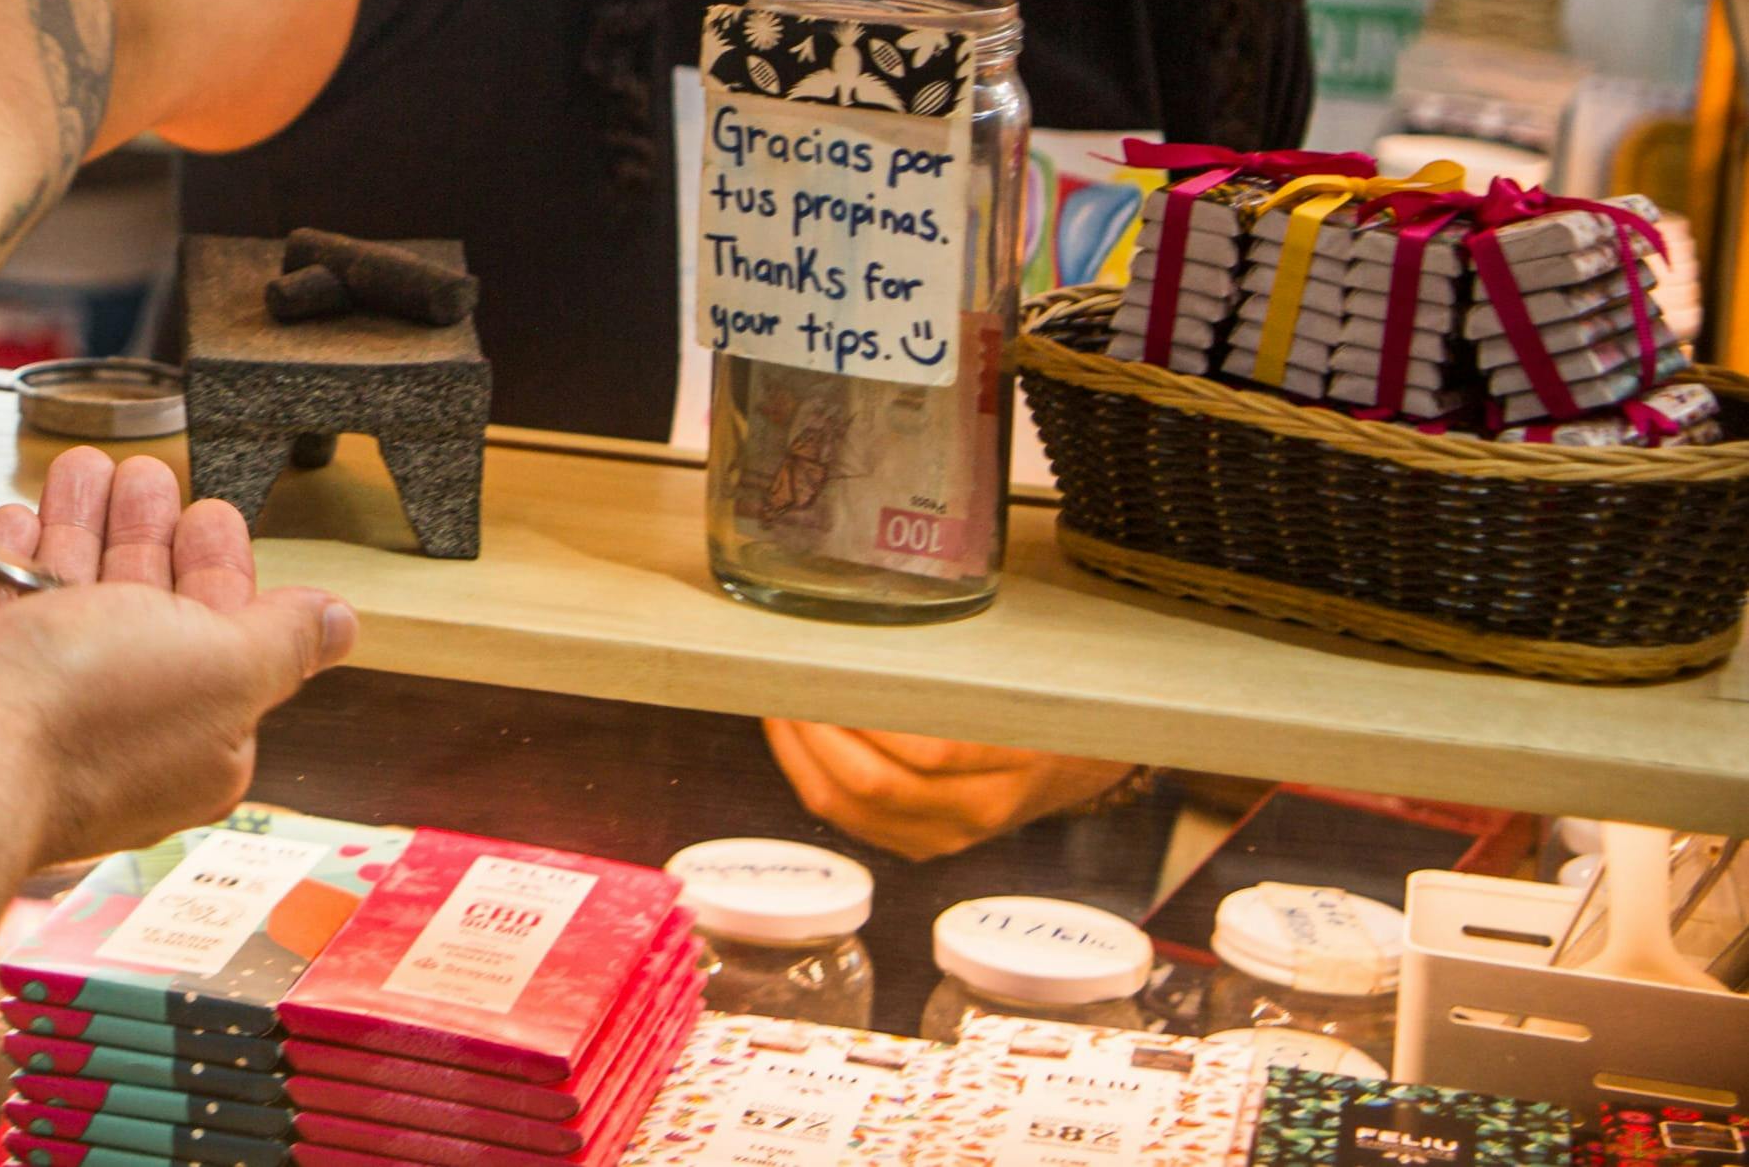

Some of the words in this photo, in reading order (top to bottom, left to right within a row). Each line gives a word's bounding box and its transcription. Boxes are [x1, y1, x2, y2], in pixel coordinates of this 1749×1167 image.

[712, 105, 873, 174] Gracias
[886, 147, 955, 188] por
[709, 173, 777, 218] tus
[792, 190, 950, 246] propinas.
[703, 232, 848, 300] Thanks
[863, 261, 924, 302] for
[710, 303, 781, 351] your
[796, 311, 893, 372] tips.
[885, 514, 944, 553] 100
[464, 902, 544, 927] CBD
[742, 1109, 834, 1133] 57%
[1028, 1121, 1122, 1147] 58%
[1355, 1125, 1459, 1152] FELIU
